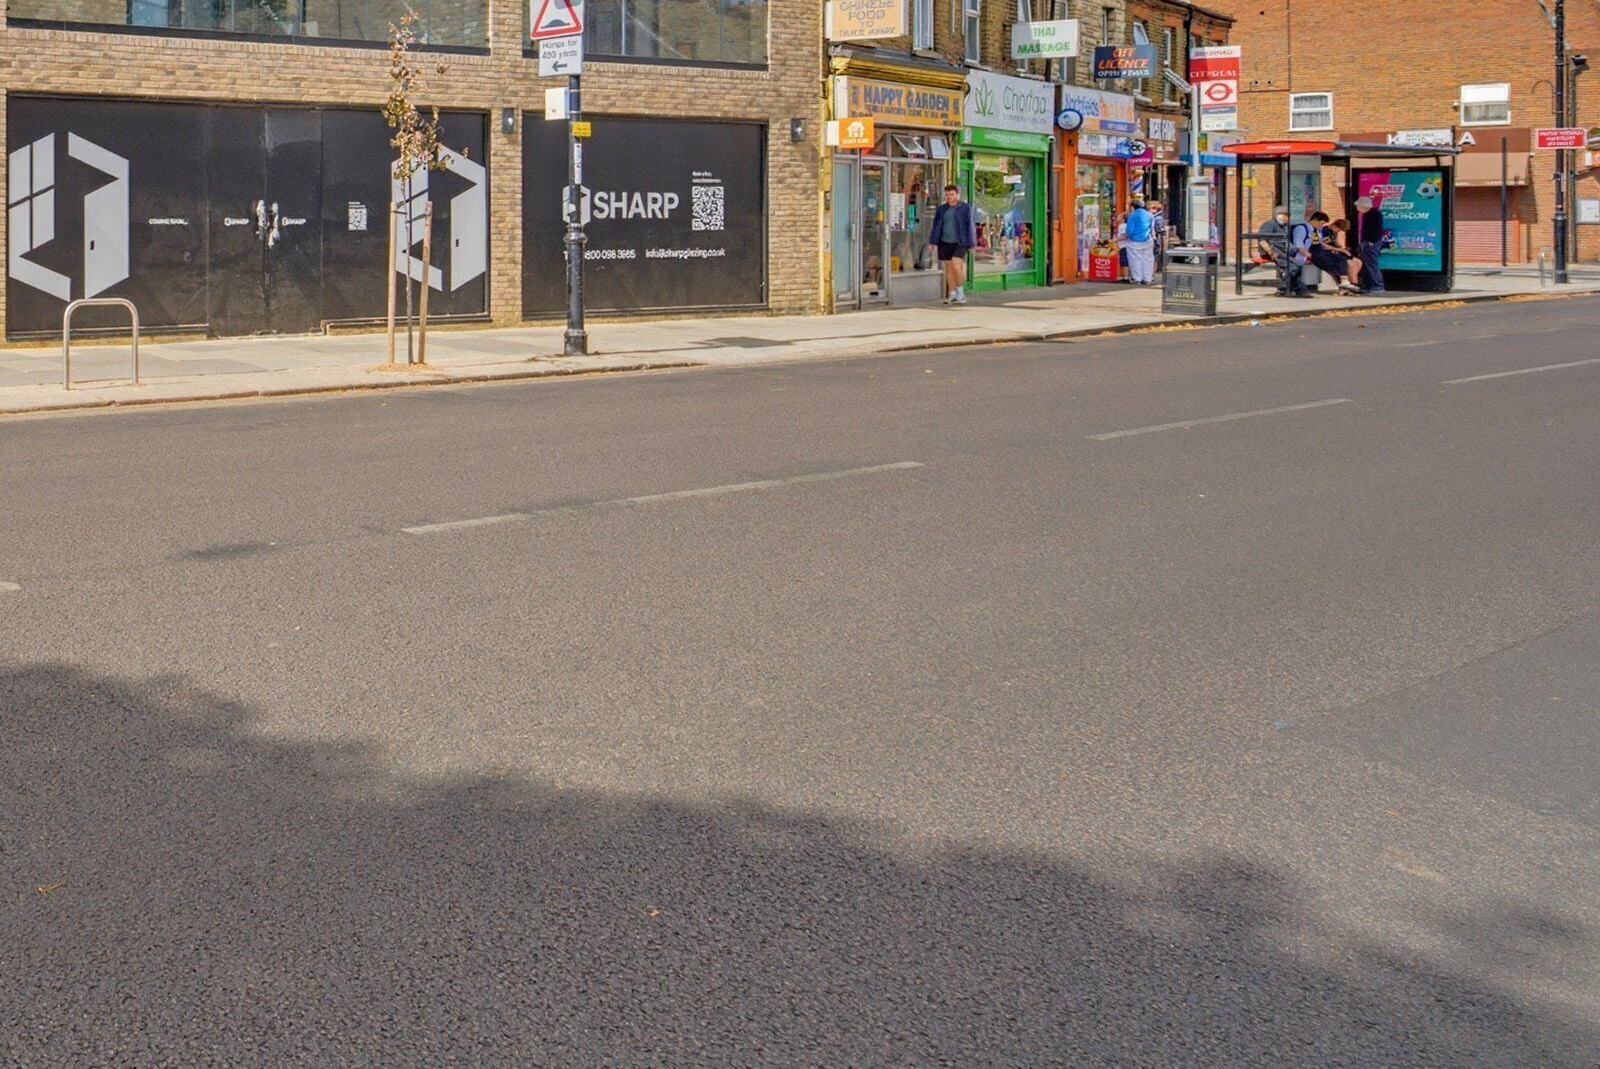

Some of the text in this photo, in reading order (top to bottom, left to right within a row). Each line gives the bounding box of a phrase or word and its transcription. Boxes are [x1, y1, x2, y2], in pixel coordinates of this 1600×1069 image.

[848, 10, 885, 21] FOOD
[1034, 27, 1056, 37] THAI
[1017, 41, 1071, 53] MASSAGE
[1113, 47, 1136, 58] OFF
[1098, 58, 1150, 69] LICENCE
[864, 85, 903, 107] HAPPY
[907, 91, 950, 111] GARDEN
[593, 191, 680, 220] SHARP
[584, 249, 601, 260] 800
